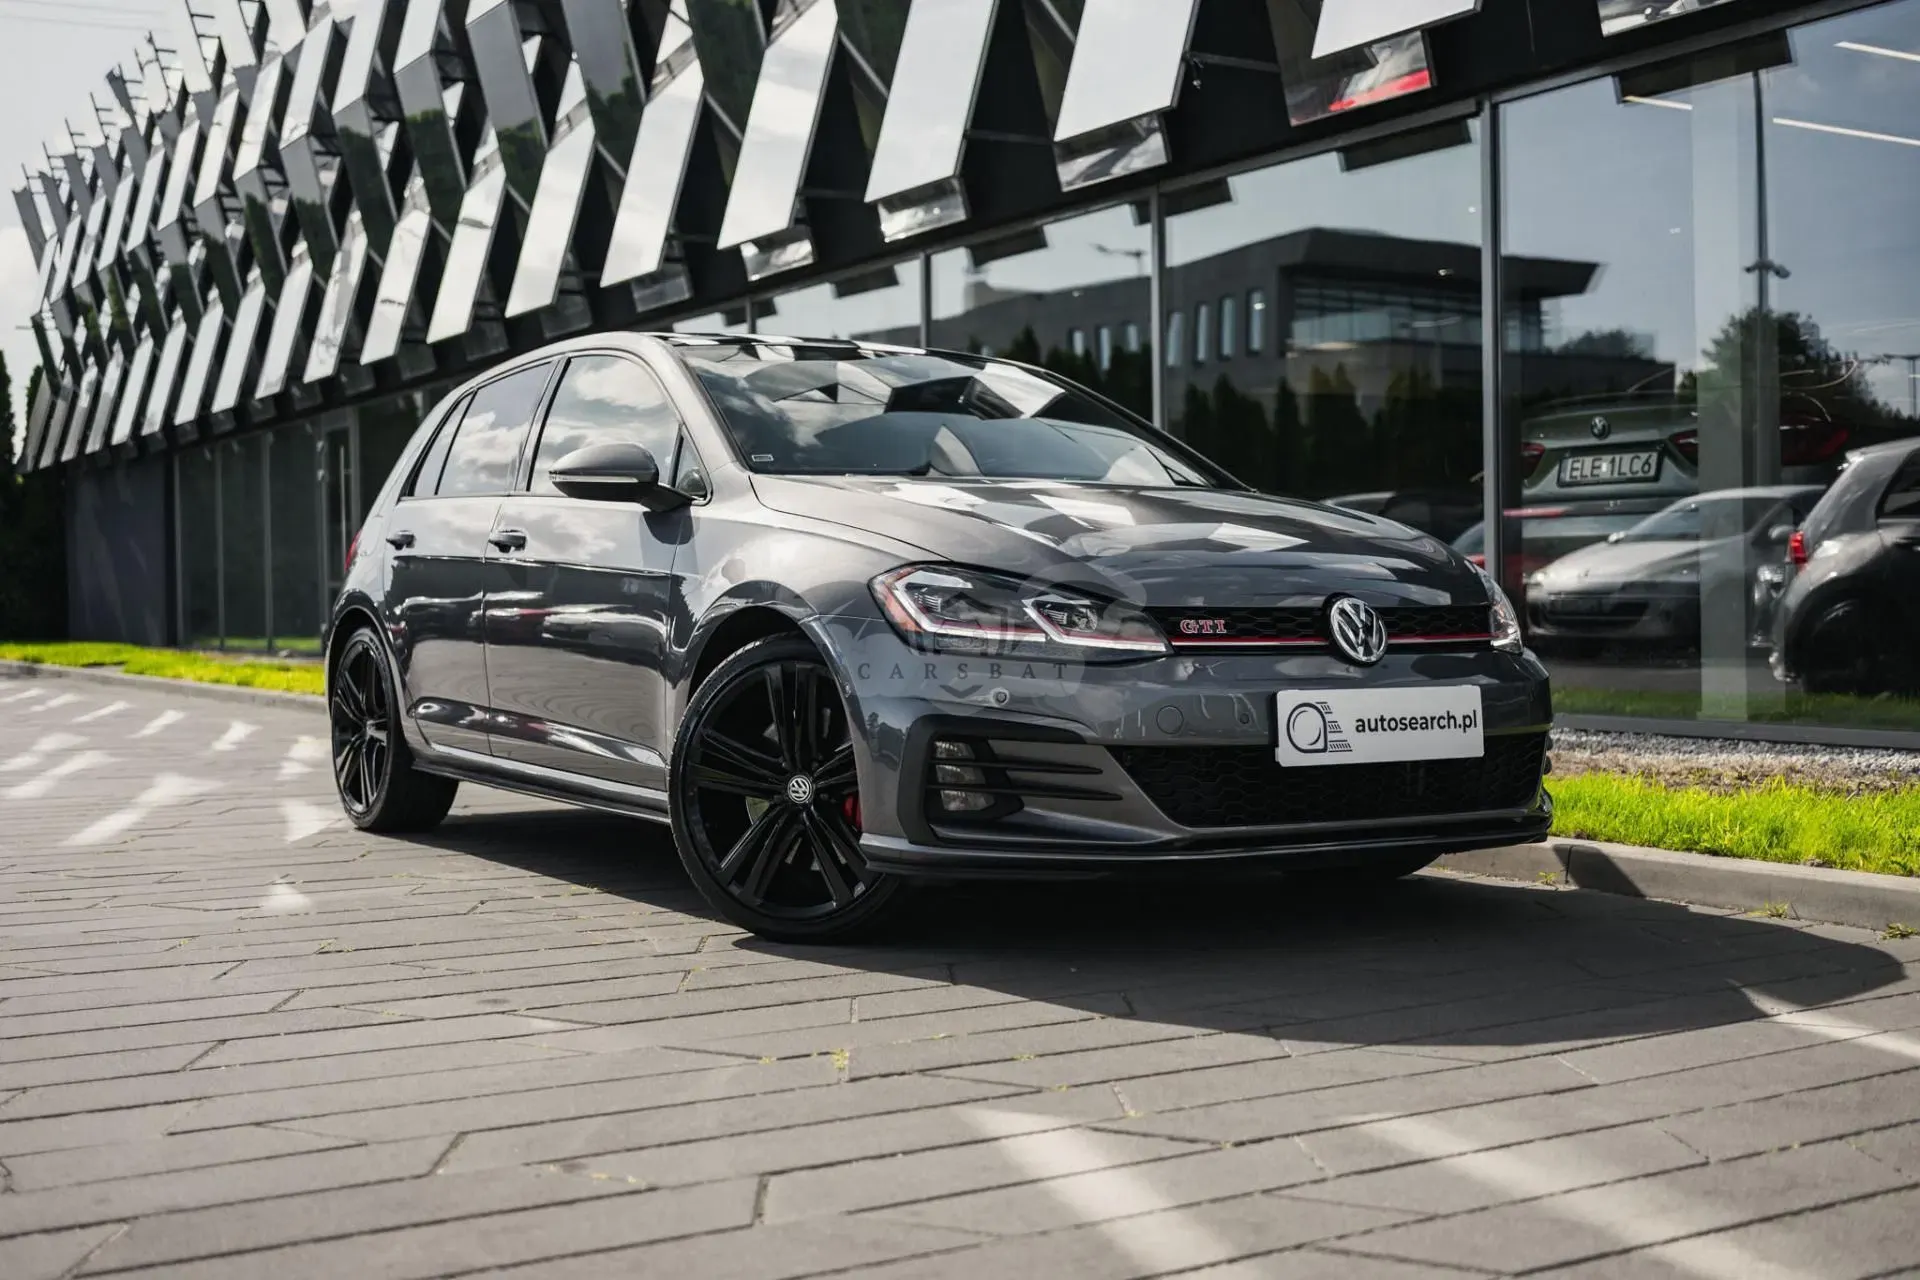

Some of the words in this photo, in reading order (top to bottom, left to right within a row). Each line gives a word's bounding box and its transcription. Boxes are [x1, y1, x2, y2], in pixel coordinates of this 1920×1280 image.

[1569, 457, 1602, 480] ELE
[1608, 454, 1653, 477] 1LC6
[1180, 619, 1227, 633] GTI
[1355, 709, 1477, 733] autosearch.pl
